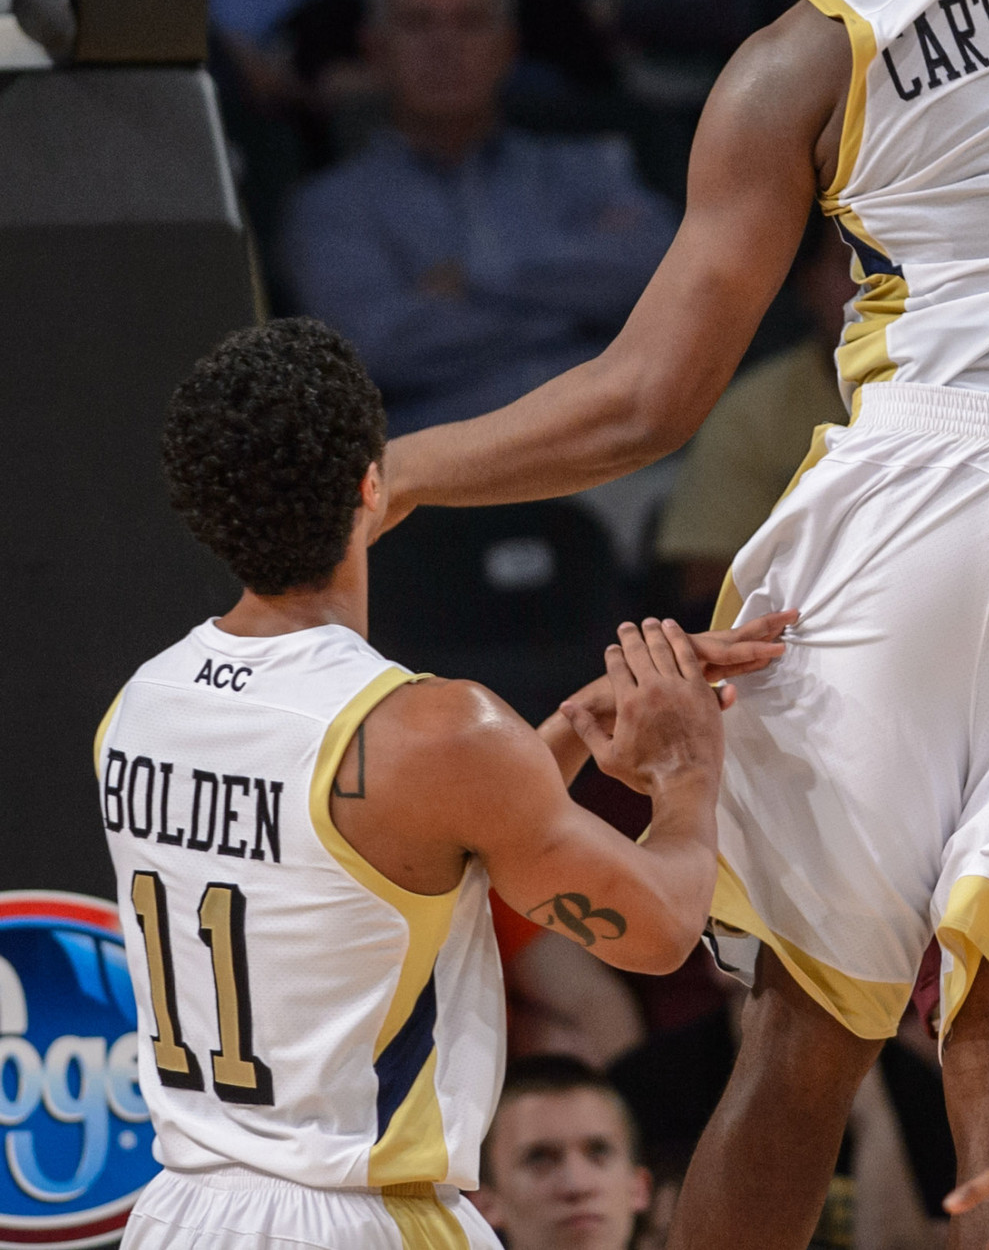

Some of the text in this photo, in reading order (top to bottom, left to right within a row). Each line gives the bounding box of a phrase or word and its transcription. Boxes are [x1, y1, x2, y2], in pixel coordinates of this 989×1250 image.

[194, 658, 253, 692] ACC
[104, 747, 284, 864] BOLDEN
[131, 870, 276, 1107] 11
[0, 1031, 153, 1203] oge
